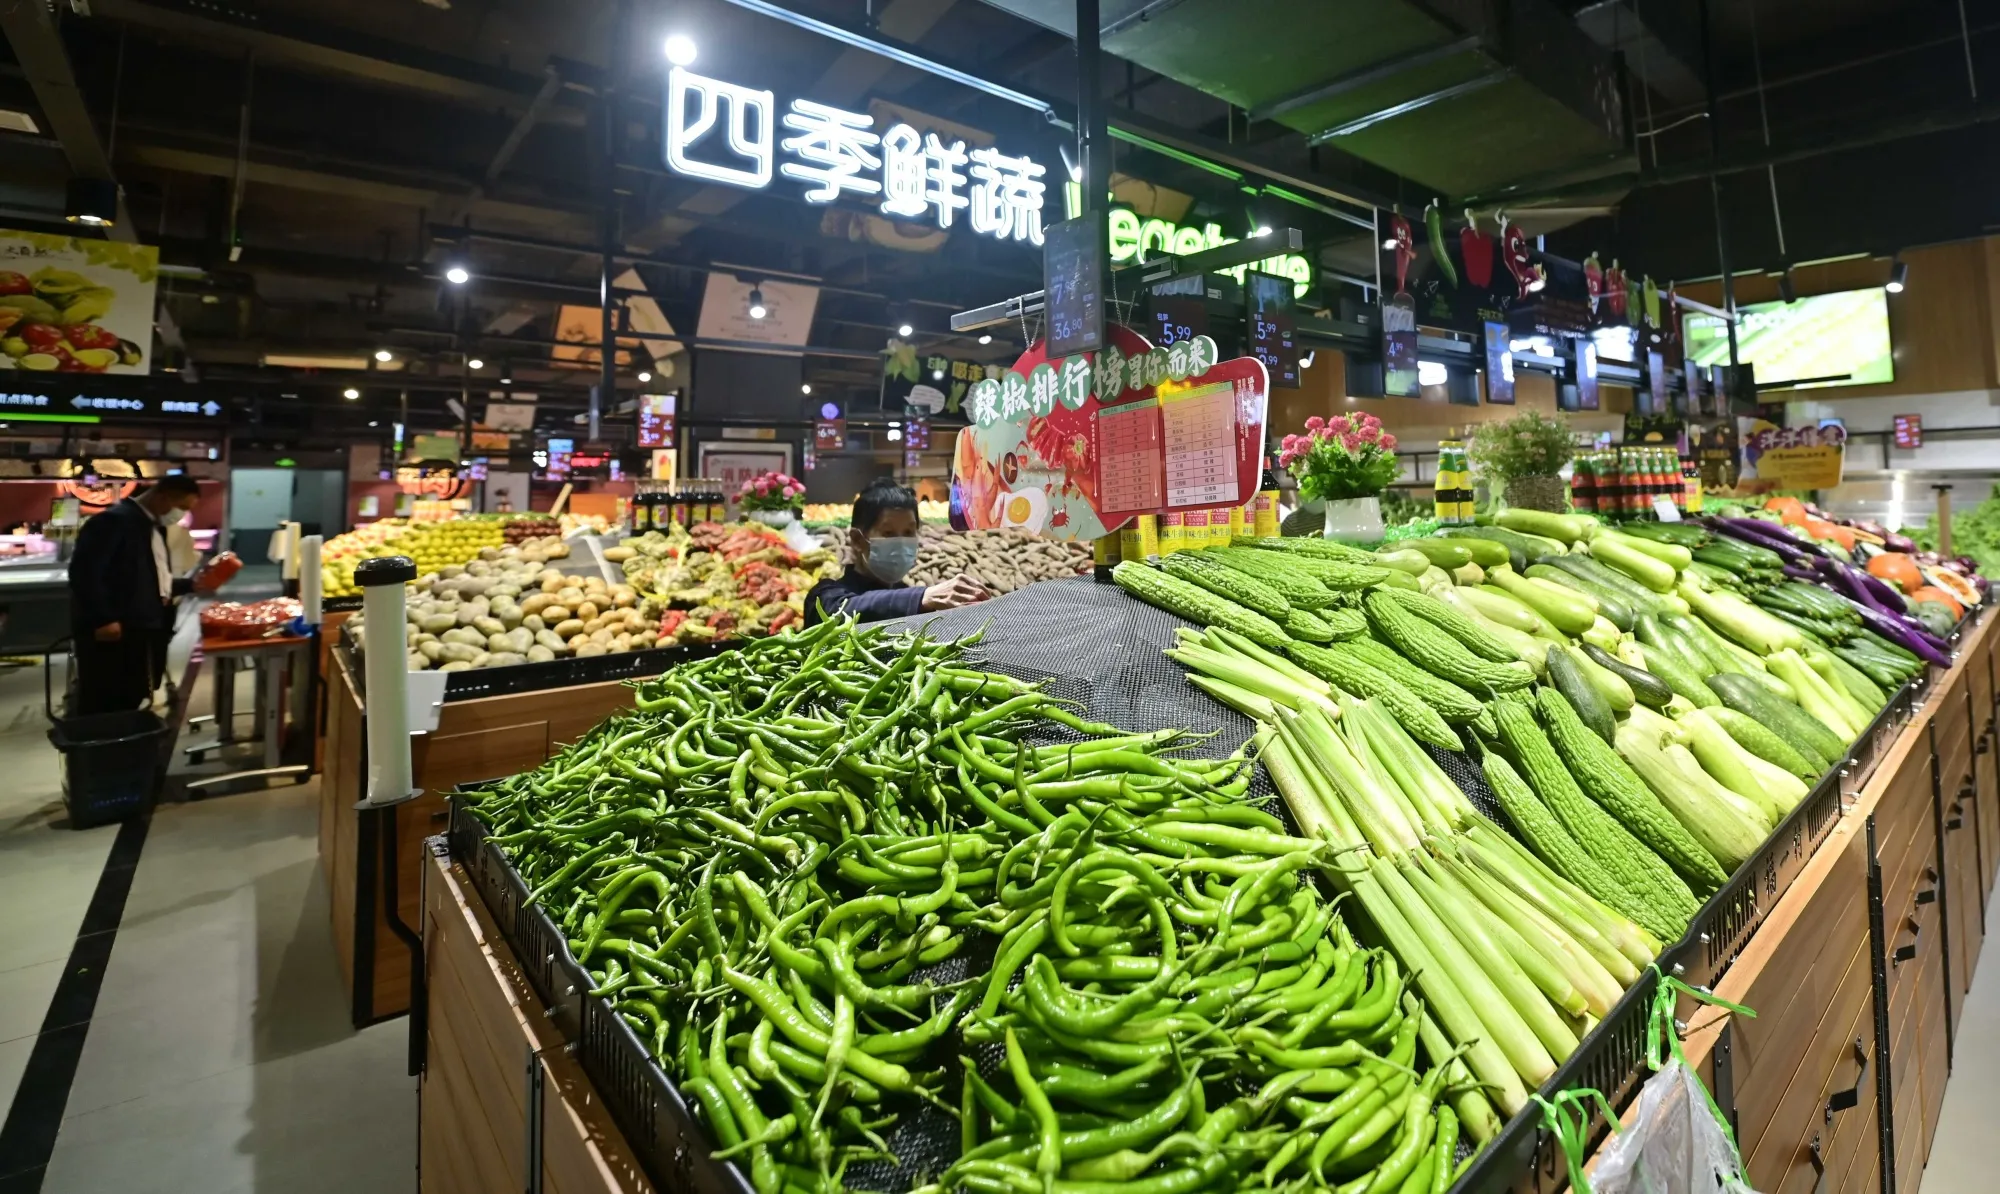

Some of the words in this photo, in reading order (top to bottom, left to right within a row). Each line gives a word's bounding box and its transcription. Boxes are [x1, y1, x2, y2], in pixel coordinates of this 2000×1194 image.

[666, 66, 1045, 246] 四季鲜蔬
[974, 345, 1126, 425] 辣椒排行榜
[1128, 339, 1211, 390] 胃你而来
